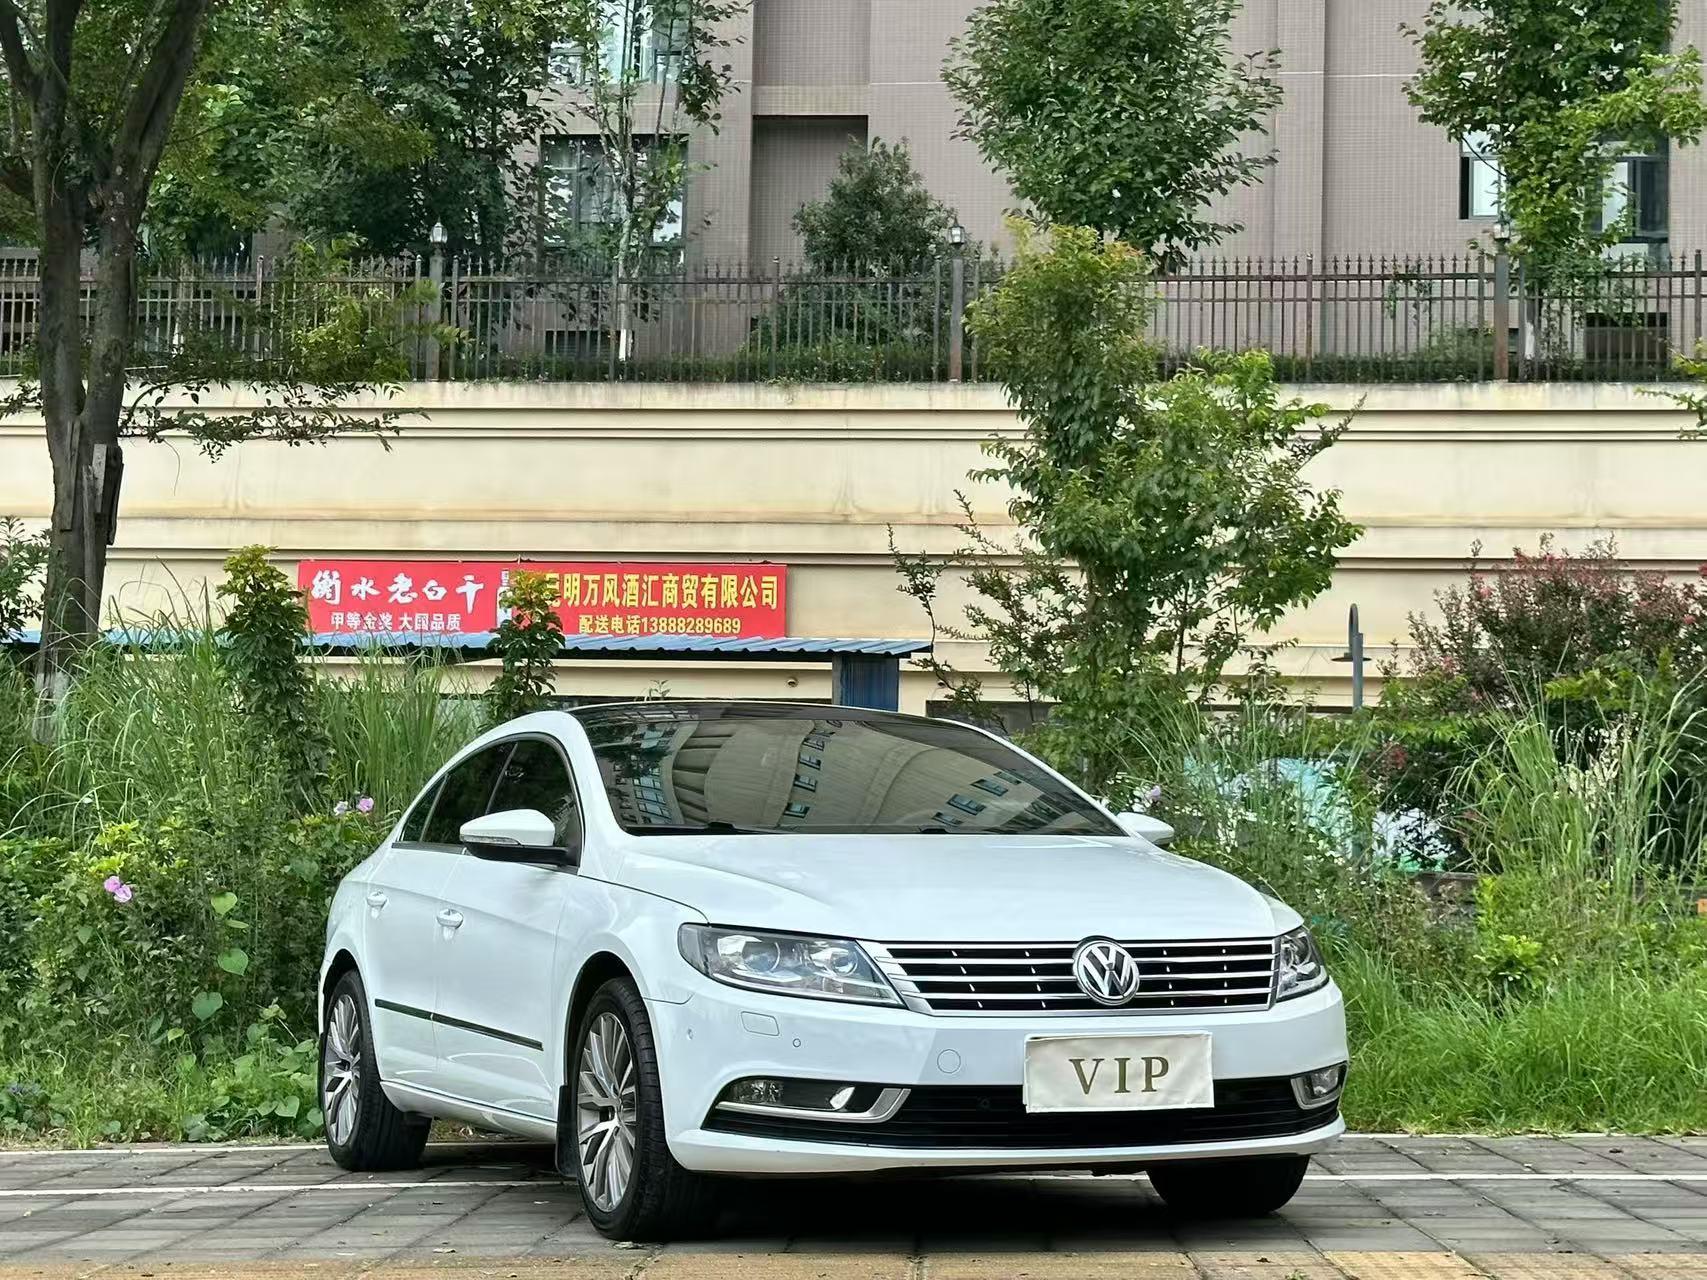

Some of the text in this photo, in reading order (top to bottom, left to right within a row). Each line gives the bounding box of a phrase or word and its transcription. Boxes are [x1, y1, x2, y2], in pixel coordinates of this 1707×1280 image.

[311, 569, 484, 614] 衡水老白干
[331, 612, 461, 631] 甲等金奖 大国品质
[579, 614, 741, 634] 配送电话13888289689
[1069, 1056, 1170, 1095] VIP
